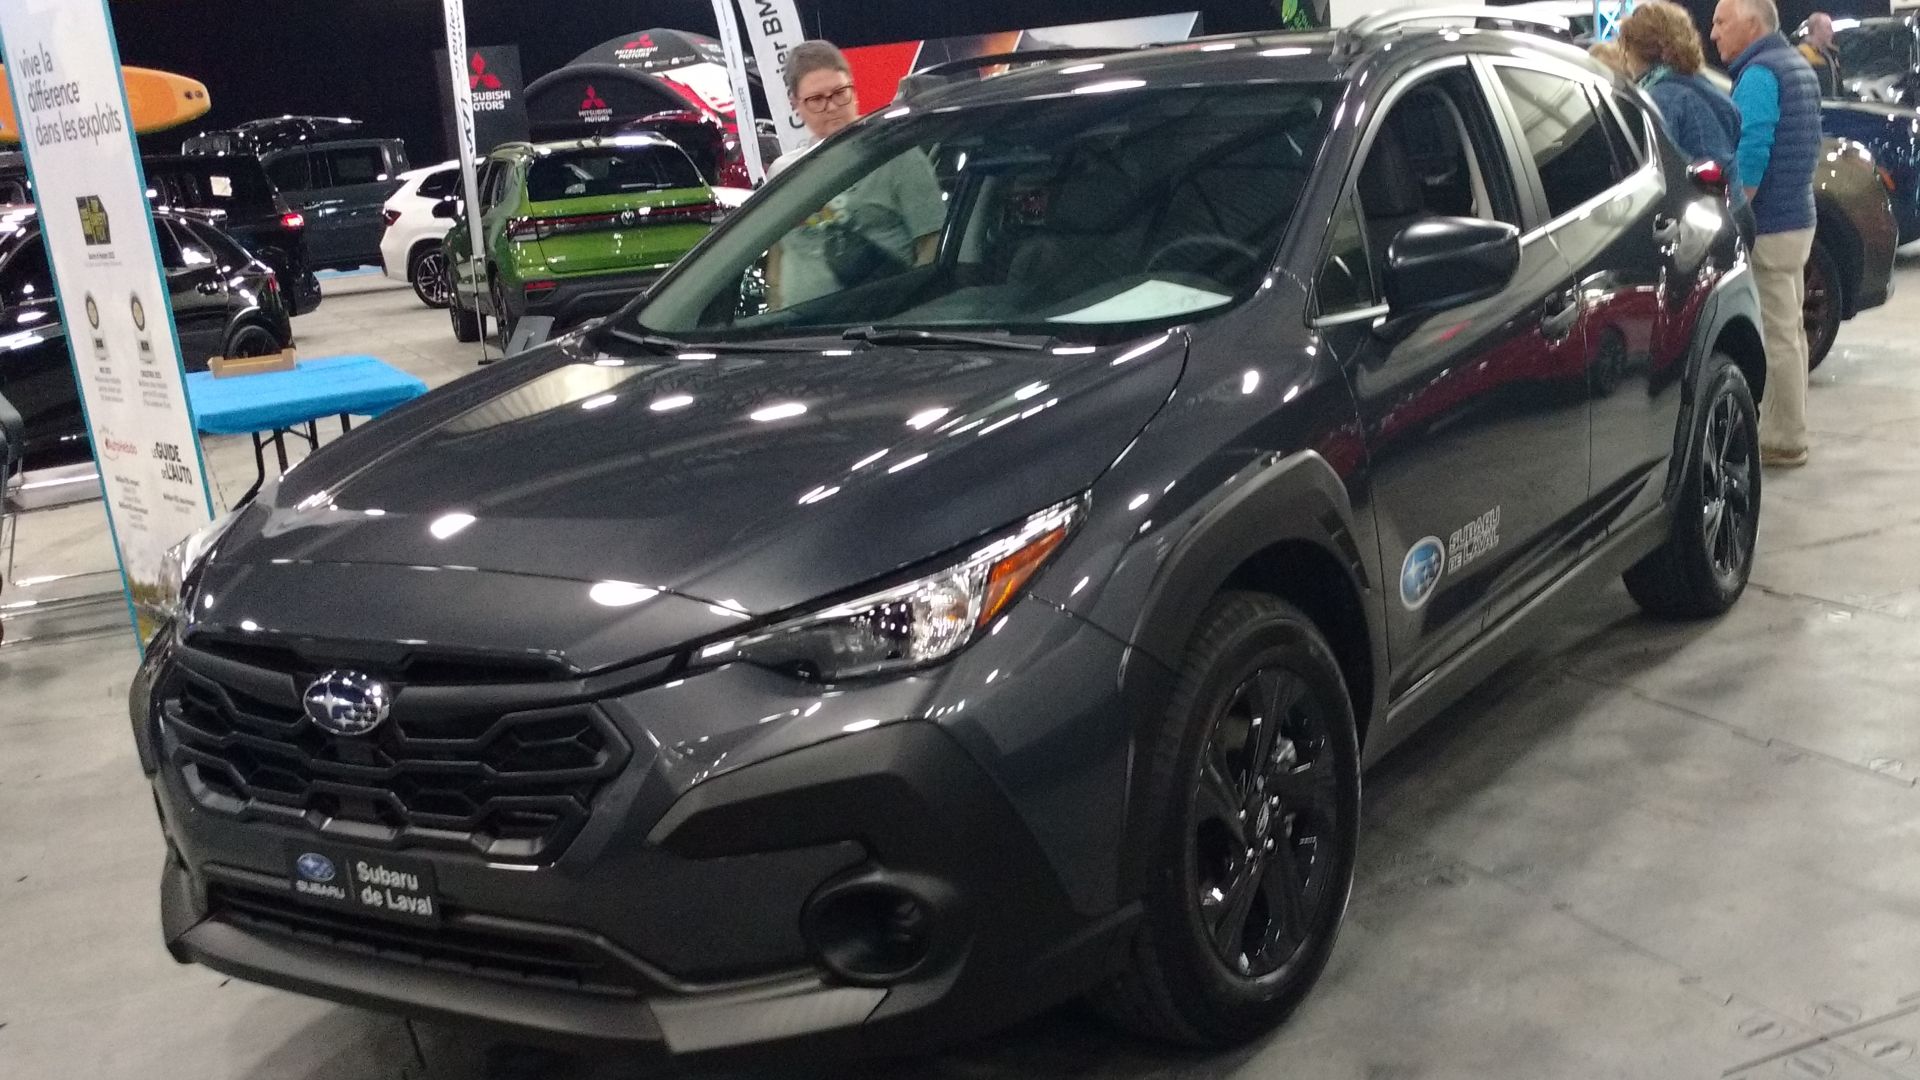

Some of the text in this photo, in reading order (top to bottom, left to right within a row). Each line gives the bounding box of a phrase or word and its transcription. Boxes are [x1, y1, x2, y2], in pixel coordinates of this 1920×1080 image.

[19, 41, 53, 79] vive la
[27, 79, 80, 113] différence
[472, 90, 511, 101] SUBISHI
[473, 100, 505, 112] OTORS
[36, 103, 122, 147] dans les exploits
[155, 442, 182, 462] GUIDE
[165, 463, 193, 485] L'AUTO
[1448, 505, 1500, 557] SUBARU
[1463, 528, 1500, 567] LAVAL
[356, 860, 419, 891] Subaru
[361, 884, 433, 916] de Laval
